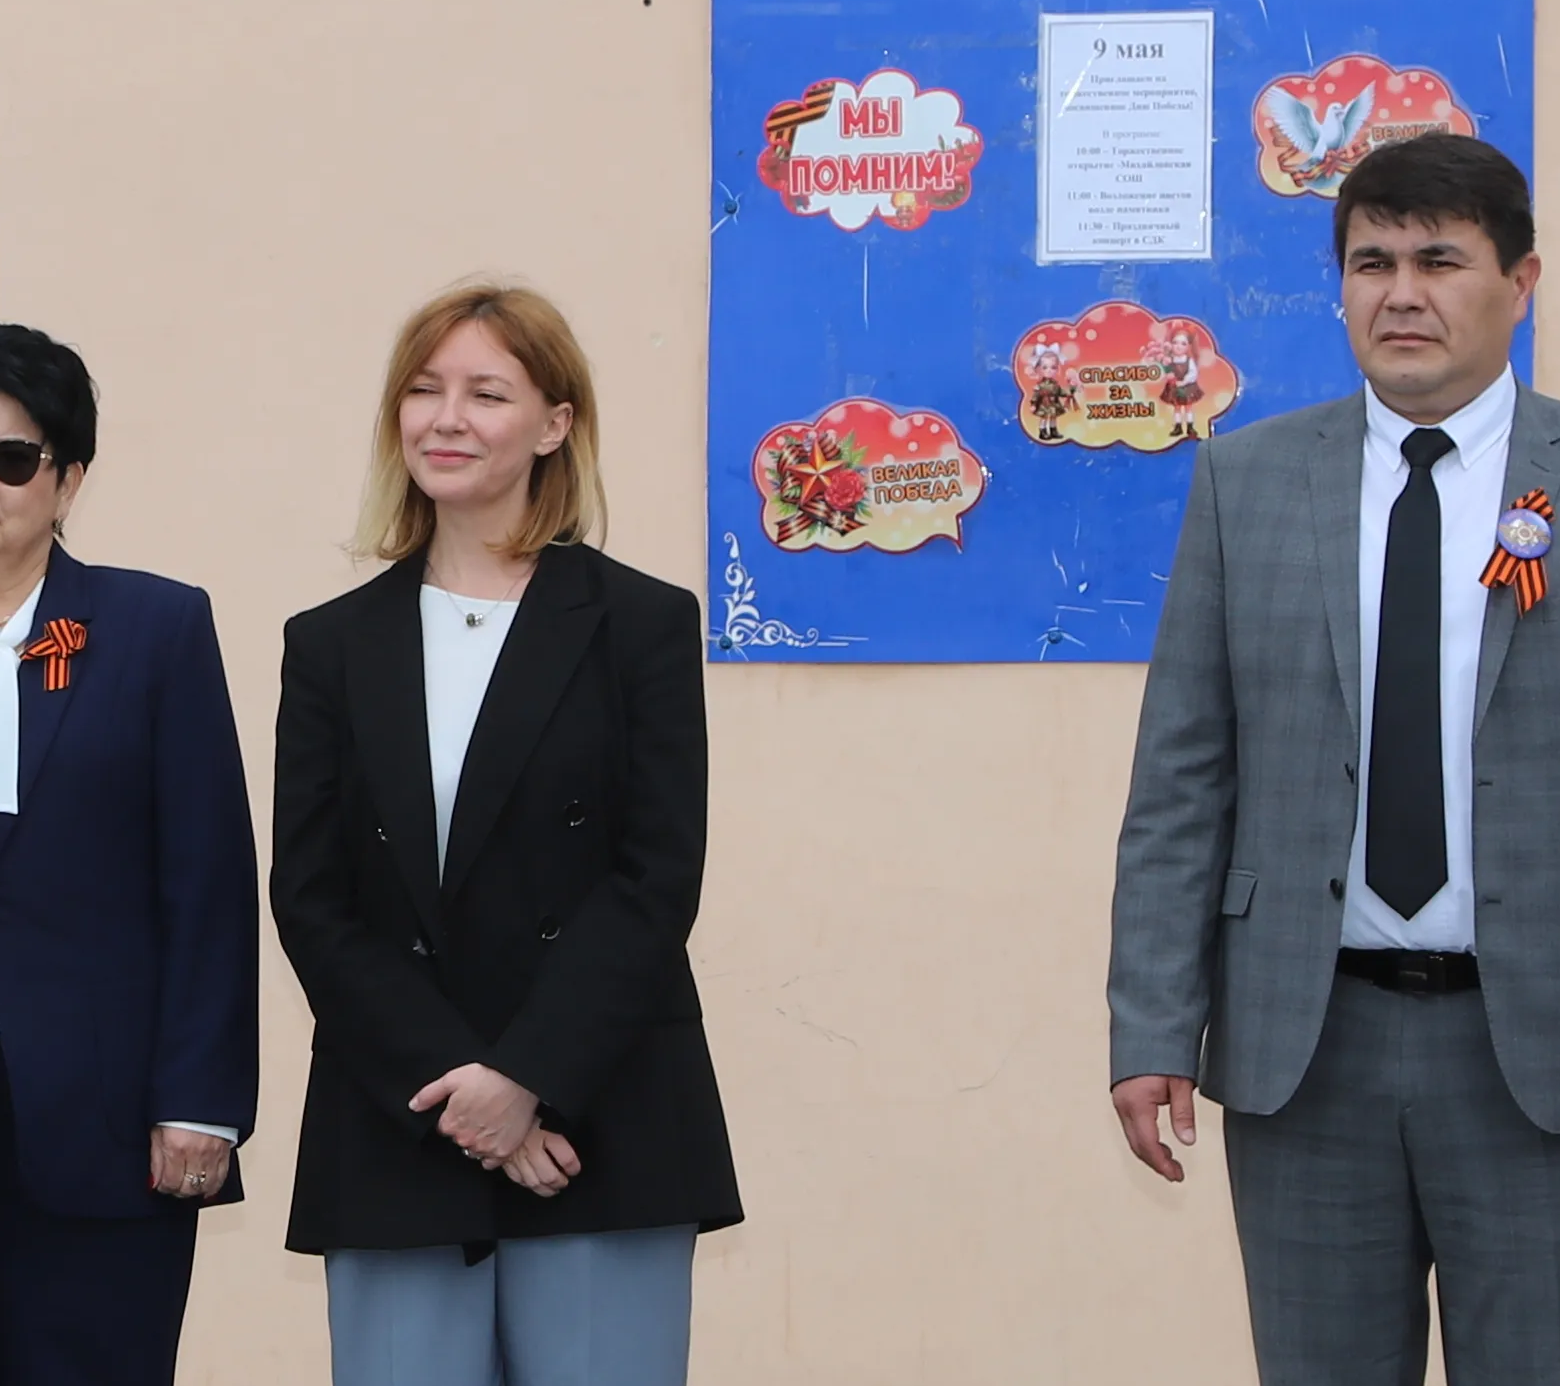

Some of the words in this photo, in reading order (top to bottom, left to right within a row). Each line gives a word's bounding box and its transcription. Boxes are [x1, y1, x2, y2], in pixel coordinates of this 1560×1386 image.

[1093, 38, 1107, 60] 9
[1116, 43, 1165, 60] мая
[840, 97, 903, 138] МЫ
[789, 153, 956, 195] ПОМНИМ!
[1080, 365, 1161, 384] СПАСИБО
[1109, 384, 1133, 401] ЗА
[1086, 401, 1155, 420] ЖИЗНЬ!
[872, 458, 960, 483] ВЕЛИКАЯ
[875, 479, 962, 504] ПОБЕДА
